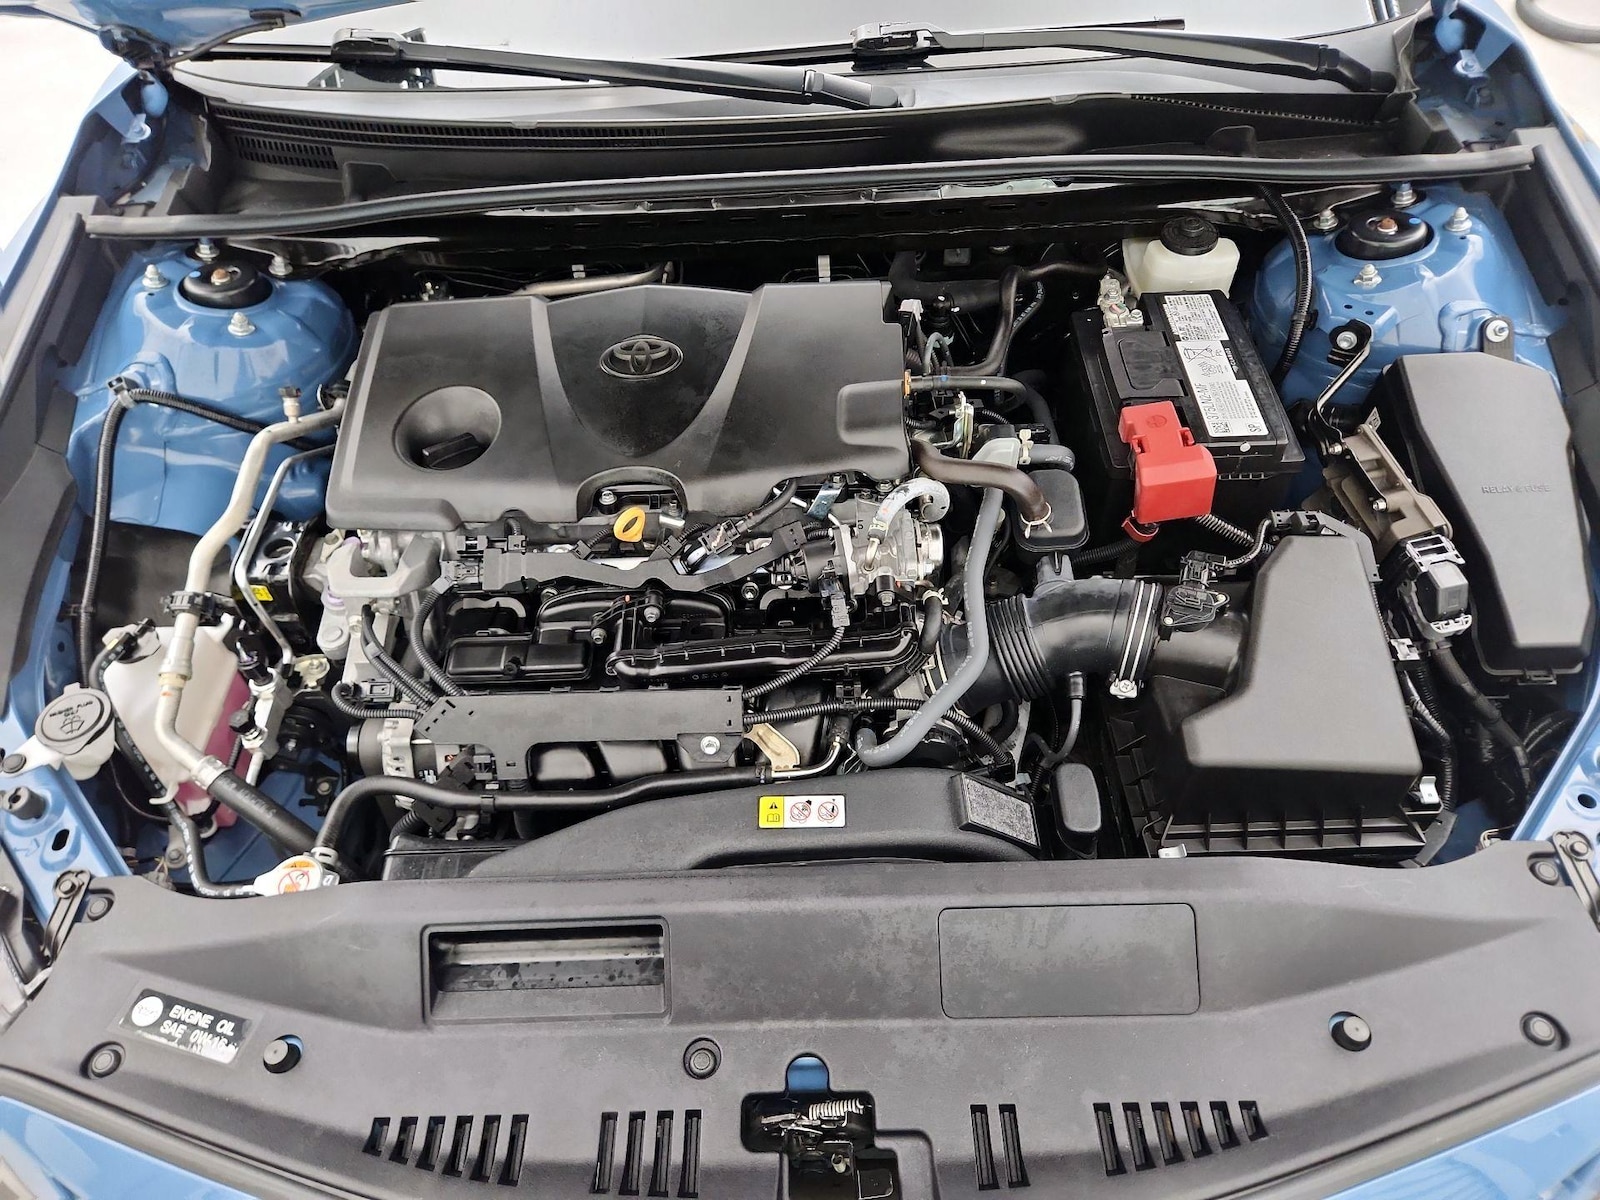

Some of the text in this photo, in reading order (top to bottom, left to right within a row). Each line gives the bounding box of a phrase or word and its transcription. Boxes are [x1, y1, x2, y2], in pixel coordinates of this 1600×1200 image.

[1481, 485, 1513, 494] RELAY
[159, 1020, 188, 1039] SAE
[168, 1004, 215, 1029] ENGINE
[215, 1019, 236, 1037] OIL
